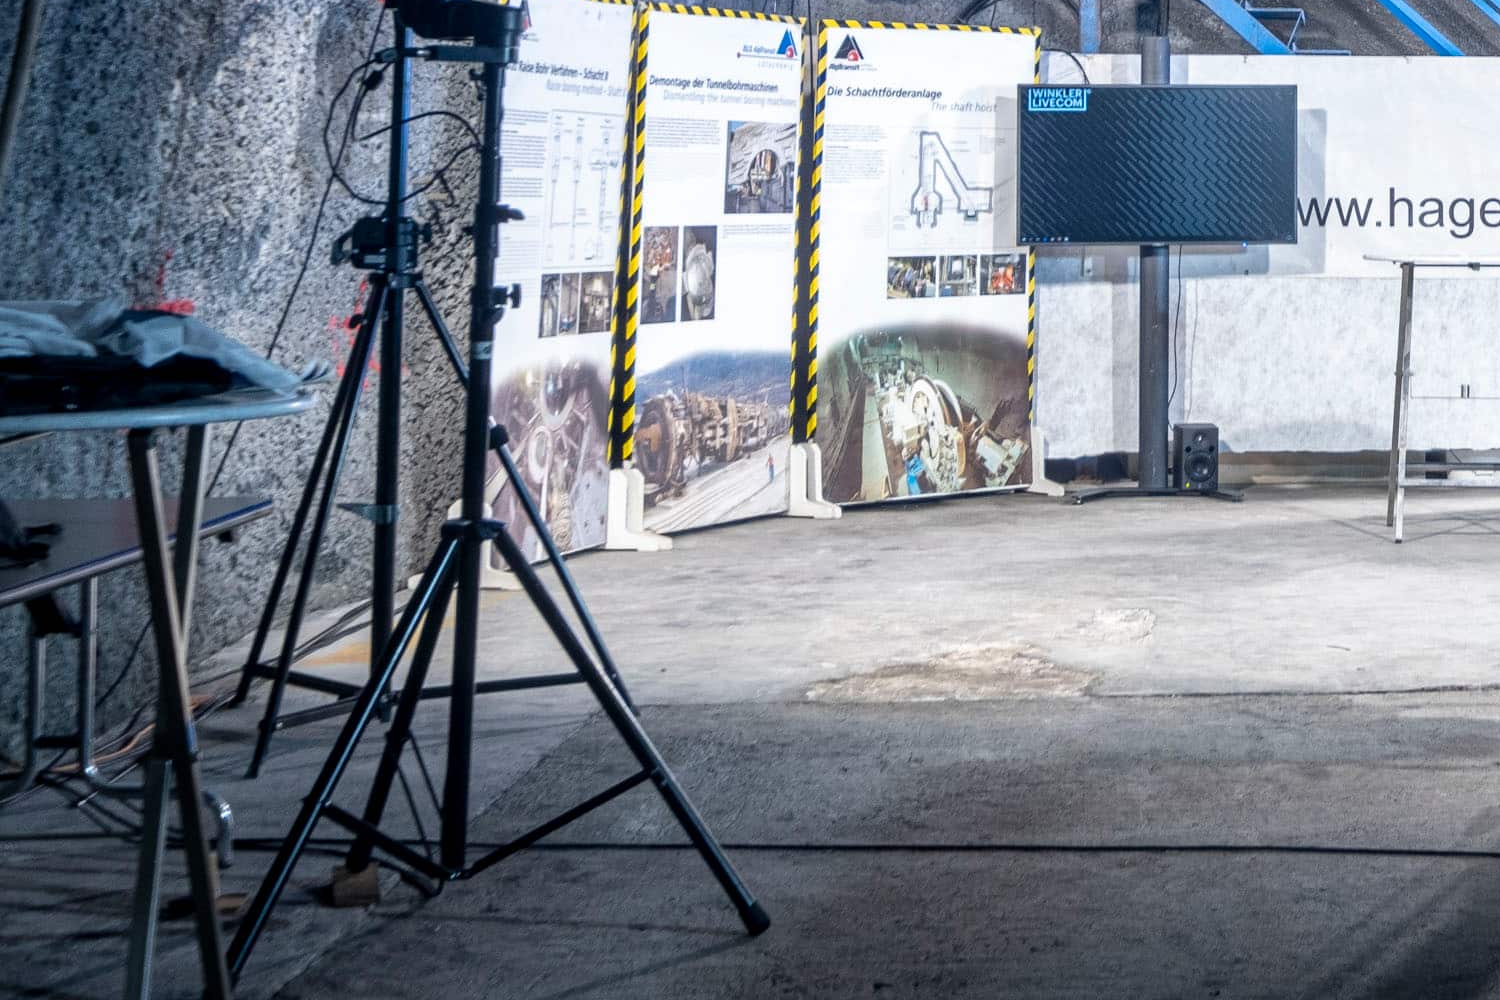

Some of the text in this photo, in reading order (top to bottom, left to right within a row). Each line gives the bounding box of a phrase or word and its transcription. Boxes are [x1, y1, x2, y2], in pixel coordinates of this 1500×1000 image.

[649, 74, 778, 93] Demontage der Tunnelbohrmaschinen
[827, 86, 943, 102] Die Schachtförderanlage
[1032, 88, 1082, 98] WINKLER
[931, 101, 999, 113] The shaft hoist
[1032, 98, 1082, 107] LIVECOM
